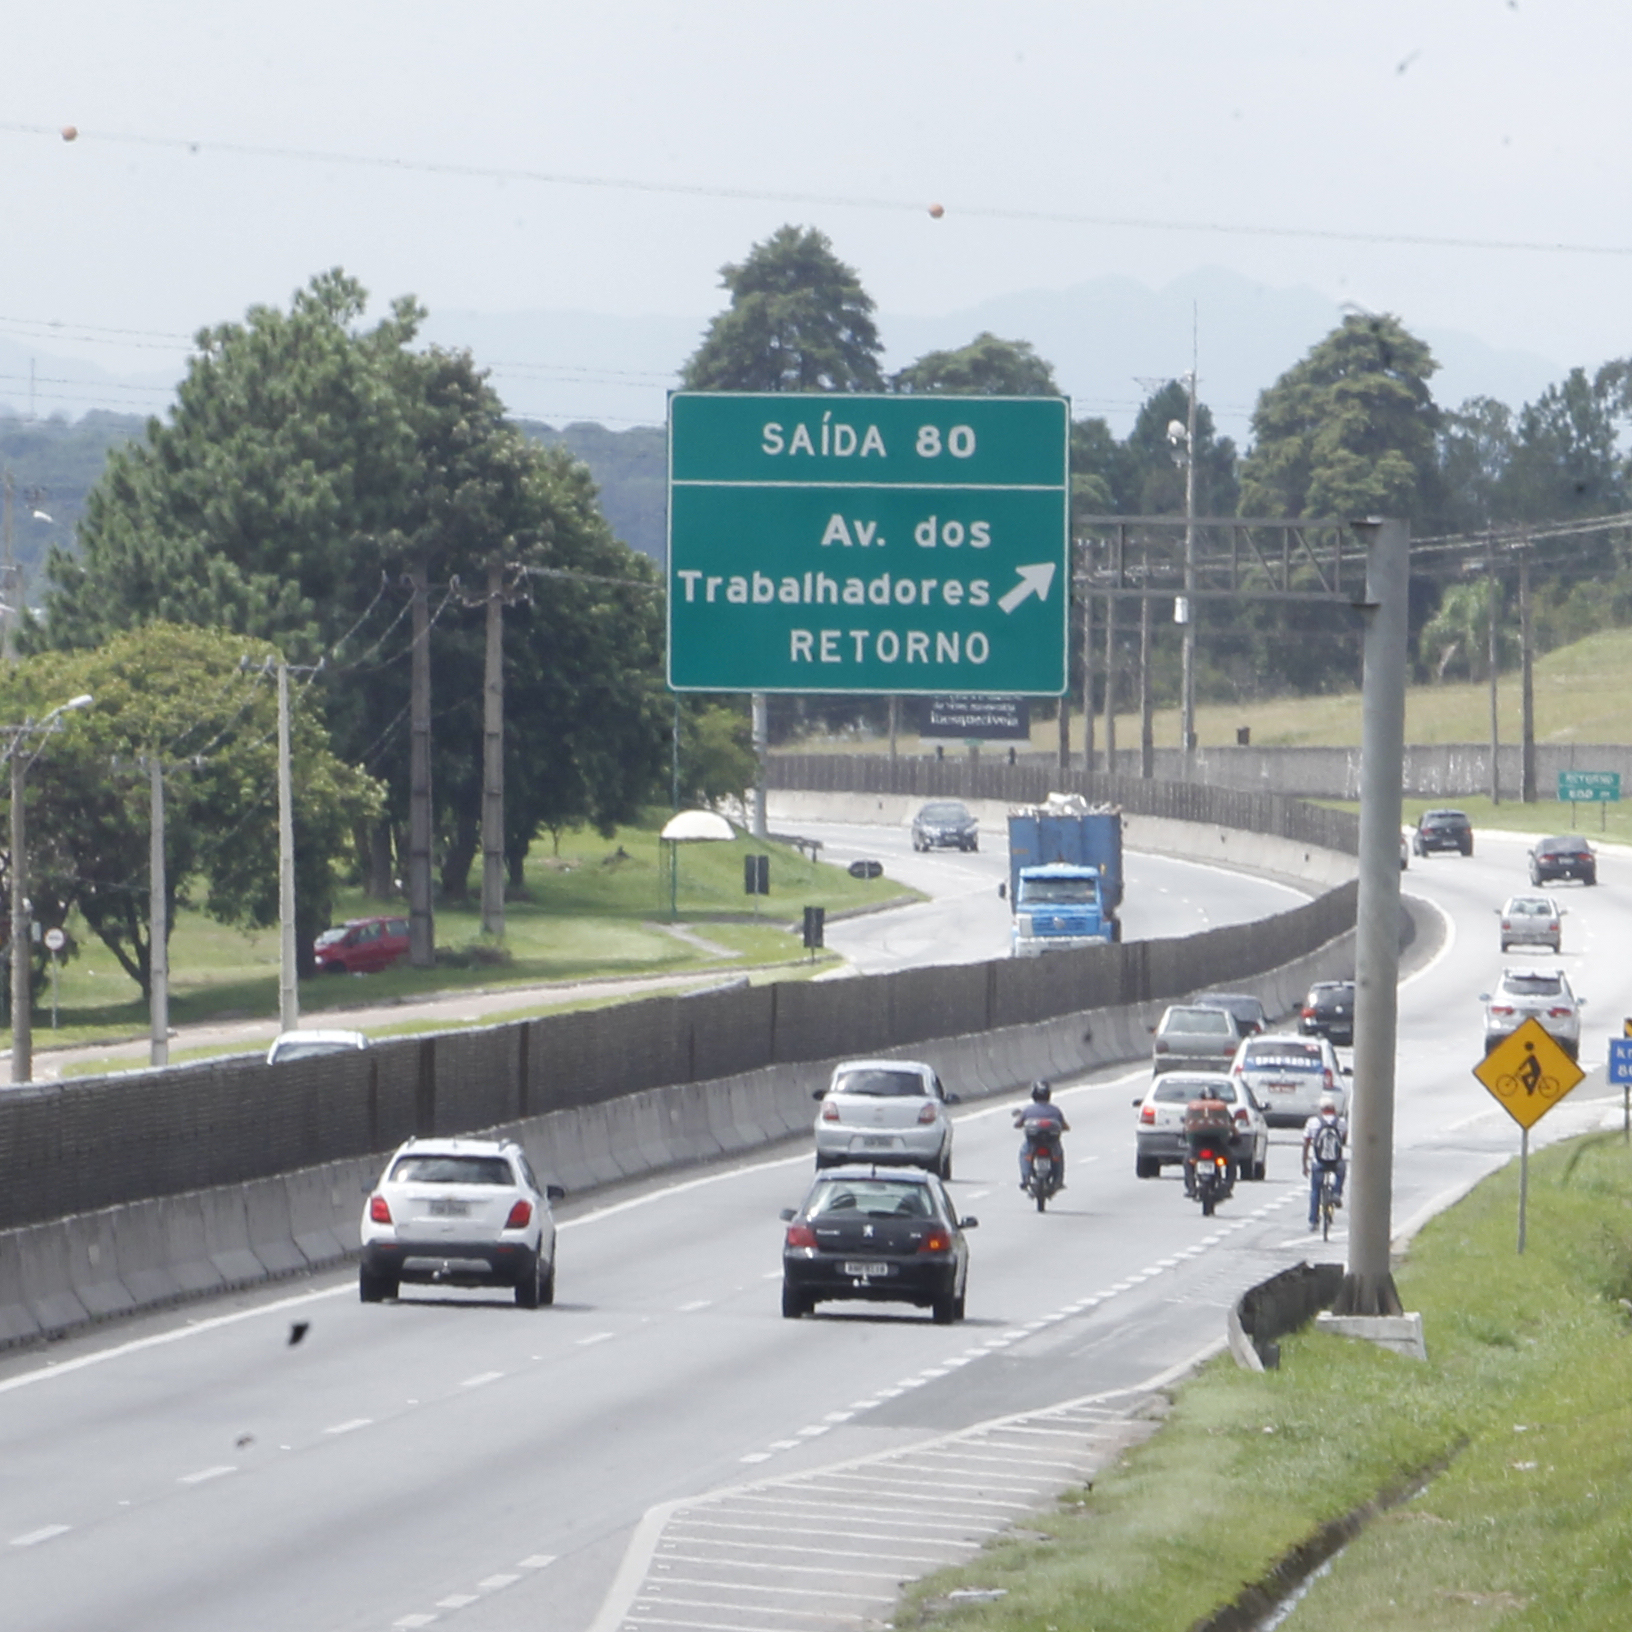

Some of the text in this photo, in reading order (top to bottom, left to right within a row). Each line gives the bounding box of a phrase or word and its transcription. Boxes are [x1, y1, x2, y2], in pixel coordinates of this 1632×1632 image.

[762, 411, 976, 458] SAÍDA 80
[821, 514, 991, 548] Av. dos
[677, 570, 990, 607] Trabalhadores
[790, 629, 990, 664] RETORNO
